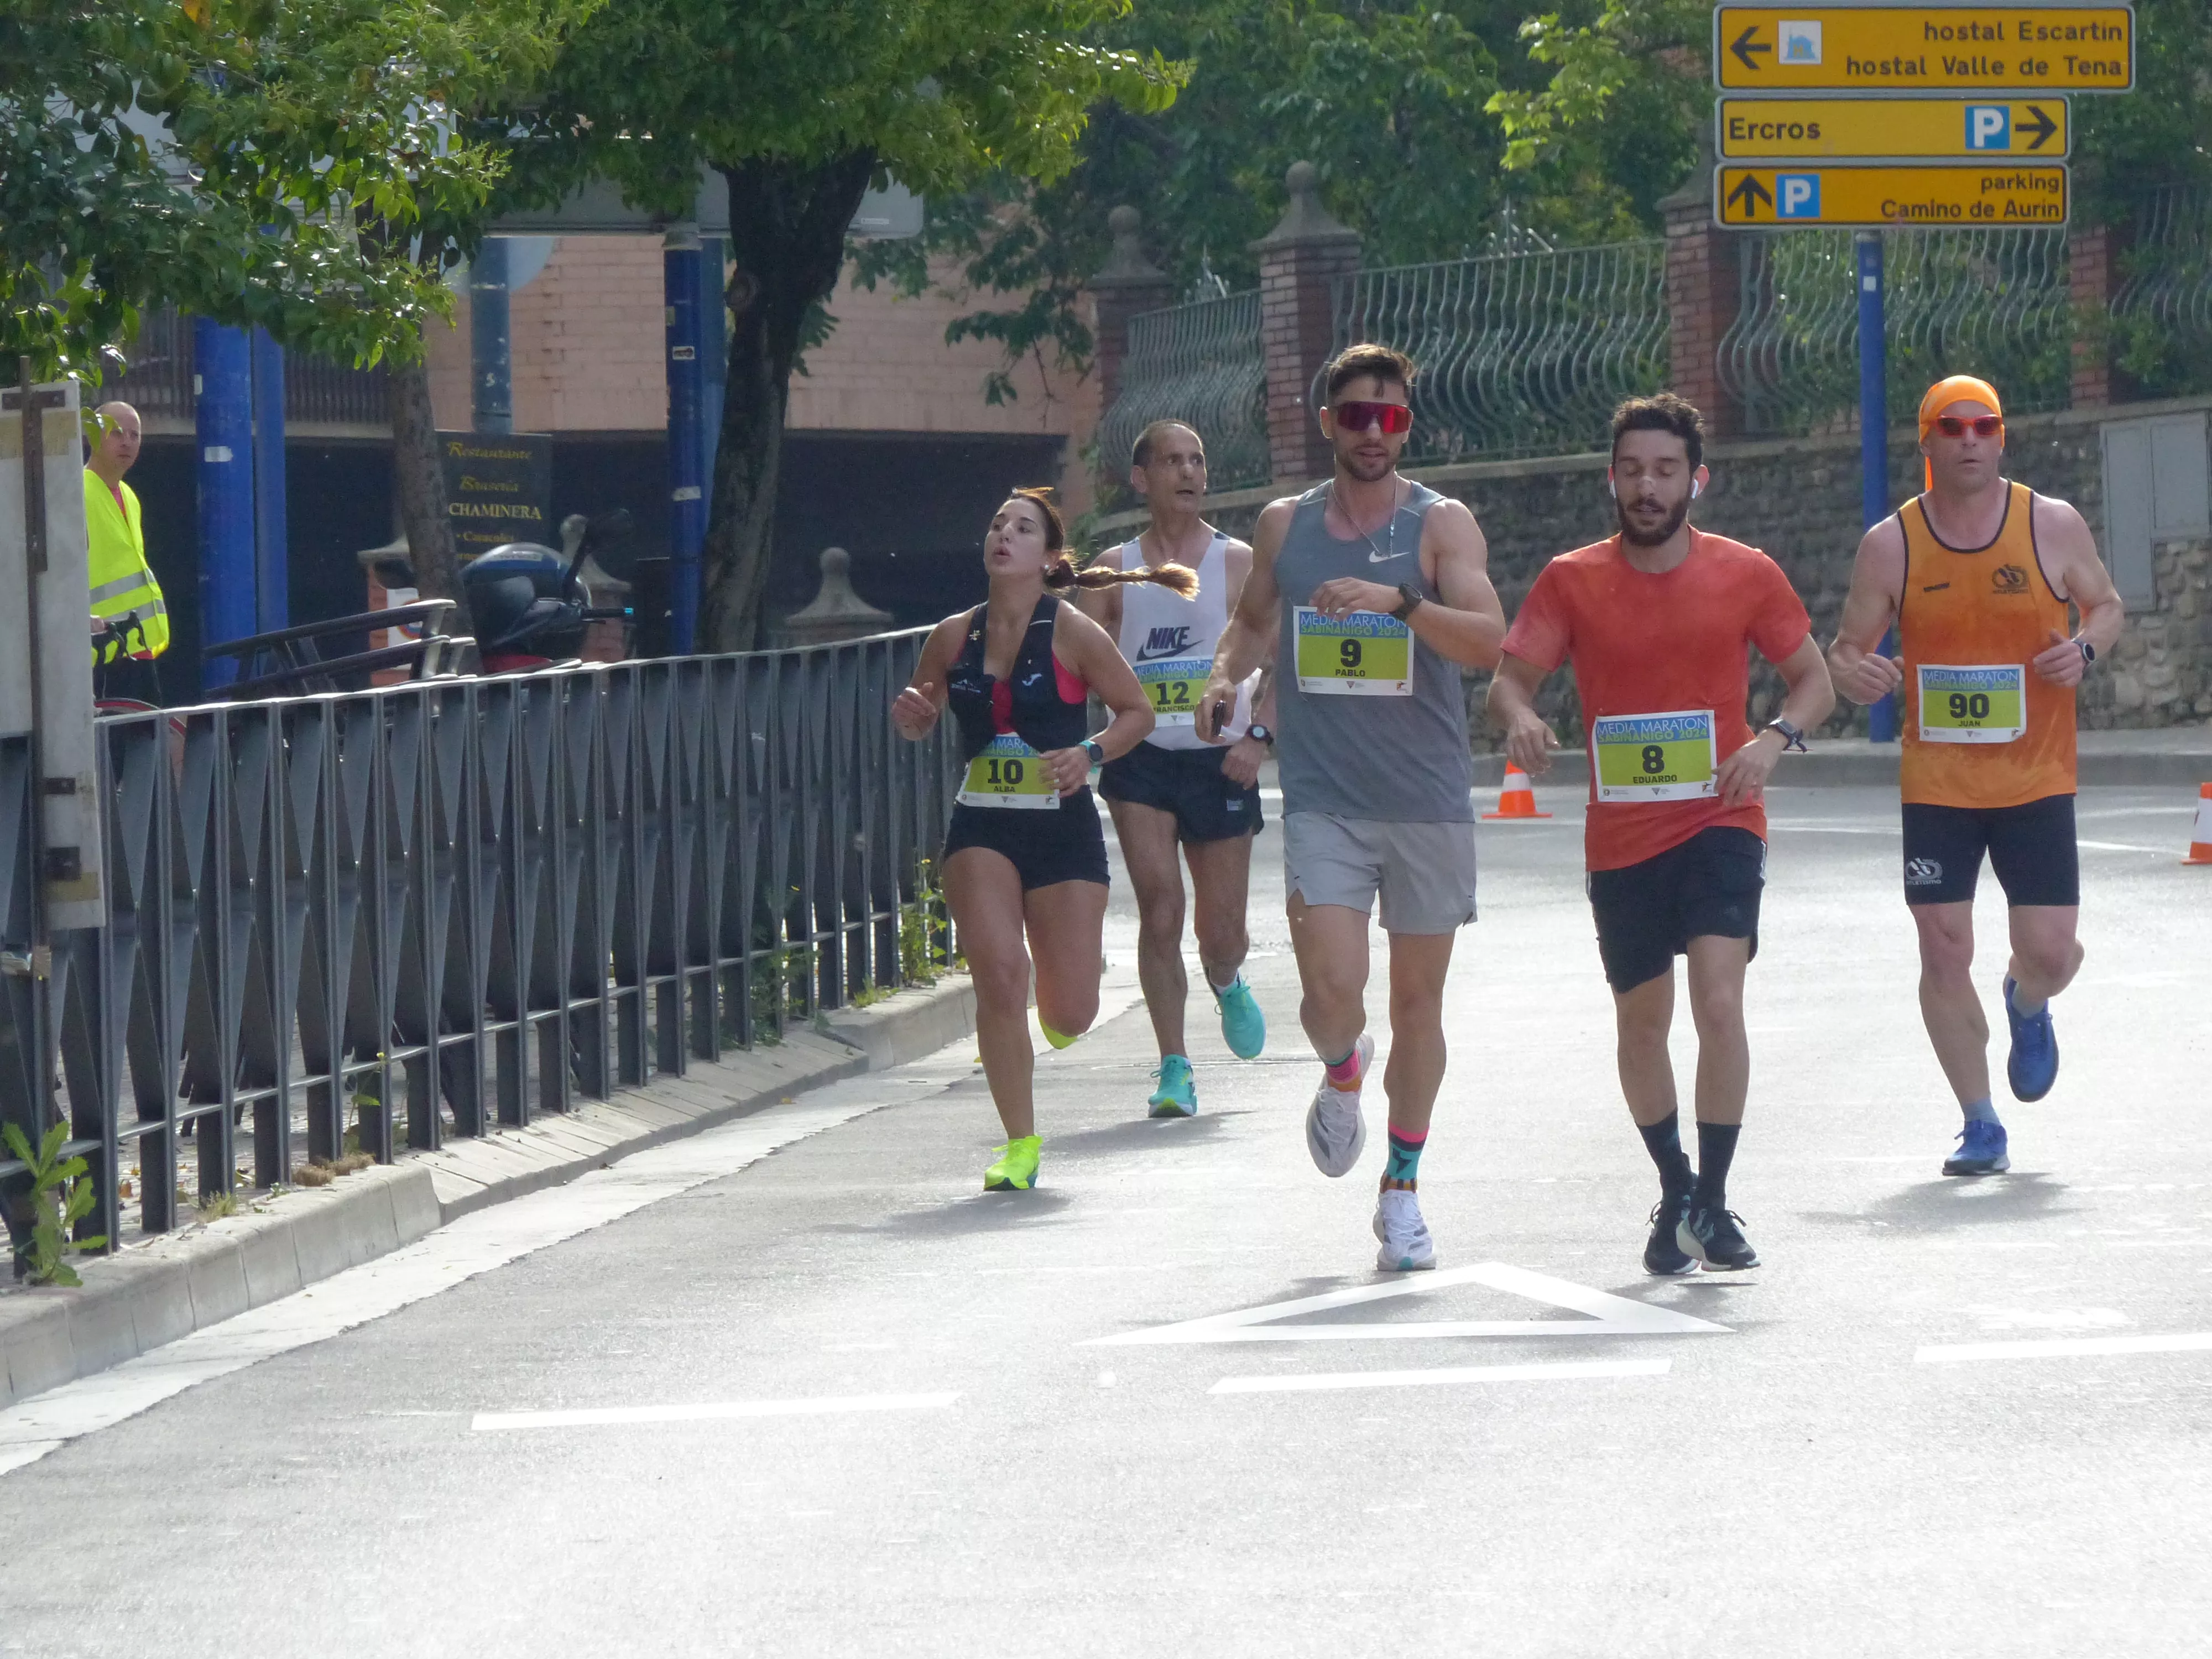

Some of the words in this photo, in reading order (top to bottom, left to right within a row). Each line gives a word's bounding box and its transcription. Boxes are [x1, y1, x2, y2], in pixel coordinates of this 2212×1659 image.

[1924, 20, 2004, 40] hostal
[1846, 55, 1927, 75] hostal
[1943, 55, 2004, 75] Valle
[2019, 55, 2048, 75] de
[2063, 55, 2122, 75] Tena
[1729, 117, 1821, 139] Ercros
[1974, 108, 2004, 147] P
[1981, 173, 2059, 194] parking
[1785, 179, 1811, 214] P
[1881, 199, 1961, 217] Camino
[1970, 200, 1995, 217] de
[448, 503, 542, 520] CHAMINERA
[1301, 614, 1340, 626] MEDIA
[1343, 615, 1406, 628] MARATON
[1146, 626, 1190, 650] NIKE
[1378, 627, 1406, 636] 2024
[1340, 639, 1362, 667] 9
[1335, 669, 1366, 677] PABLO
[1924, 671, 1955, 682] MEDIA
[1959, 671, 2018, 683] MARATON
[1156, 681, 1190, 706] 12
[1949, 693, 1990, 719] 90
[1597, 722, 1636, 735] MEDIA
[1641, 717, 1708, 732] MARATON
[1679, 728, 1708, 739] 2024
[997, 738, 1029, 748] MARA
[1642, 745, 1665, 774] 8
[988, 759, 1023, 785] 10
[1633, 774, 1677, 784] EDUARDO
